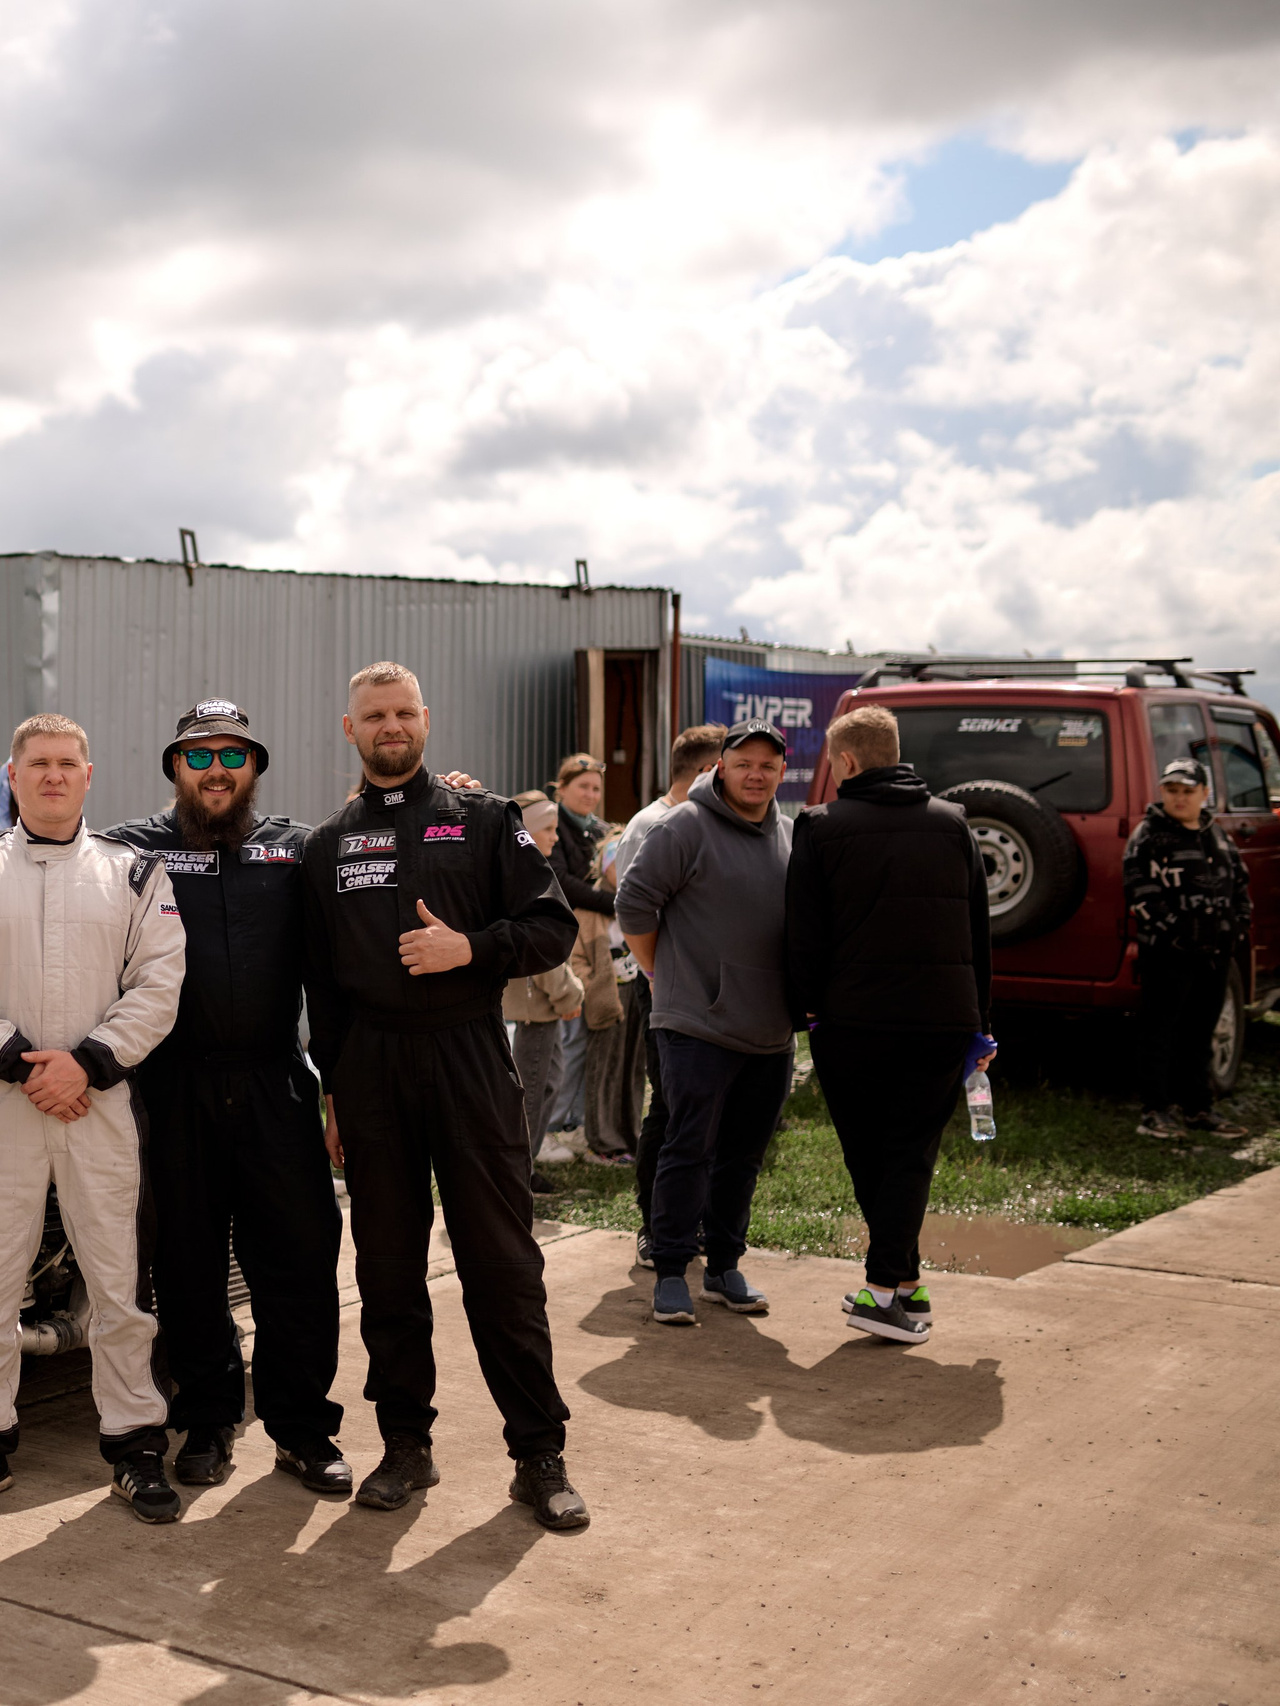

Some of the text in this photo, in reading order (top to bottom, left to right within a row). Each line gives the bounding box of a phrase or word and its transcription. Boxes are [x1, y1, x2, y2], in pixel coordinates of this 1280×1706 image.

[733, 694, 813, 728] HYPER
[958, 718, 1022, 733] SERVICE
[384, 794, 404, 804] OMP
[423, 825, 466, 838] RDS
[166, 862, 209, 873] CREW
[340, 862, 396, 878] CHASER
[345, 873, 389, 888] CREW
